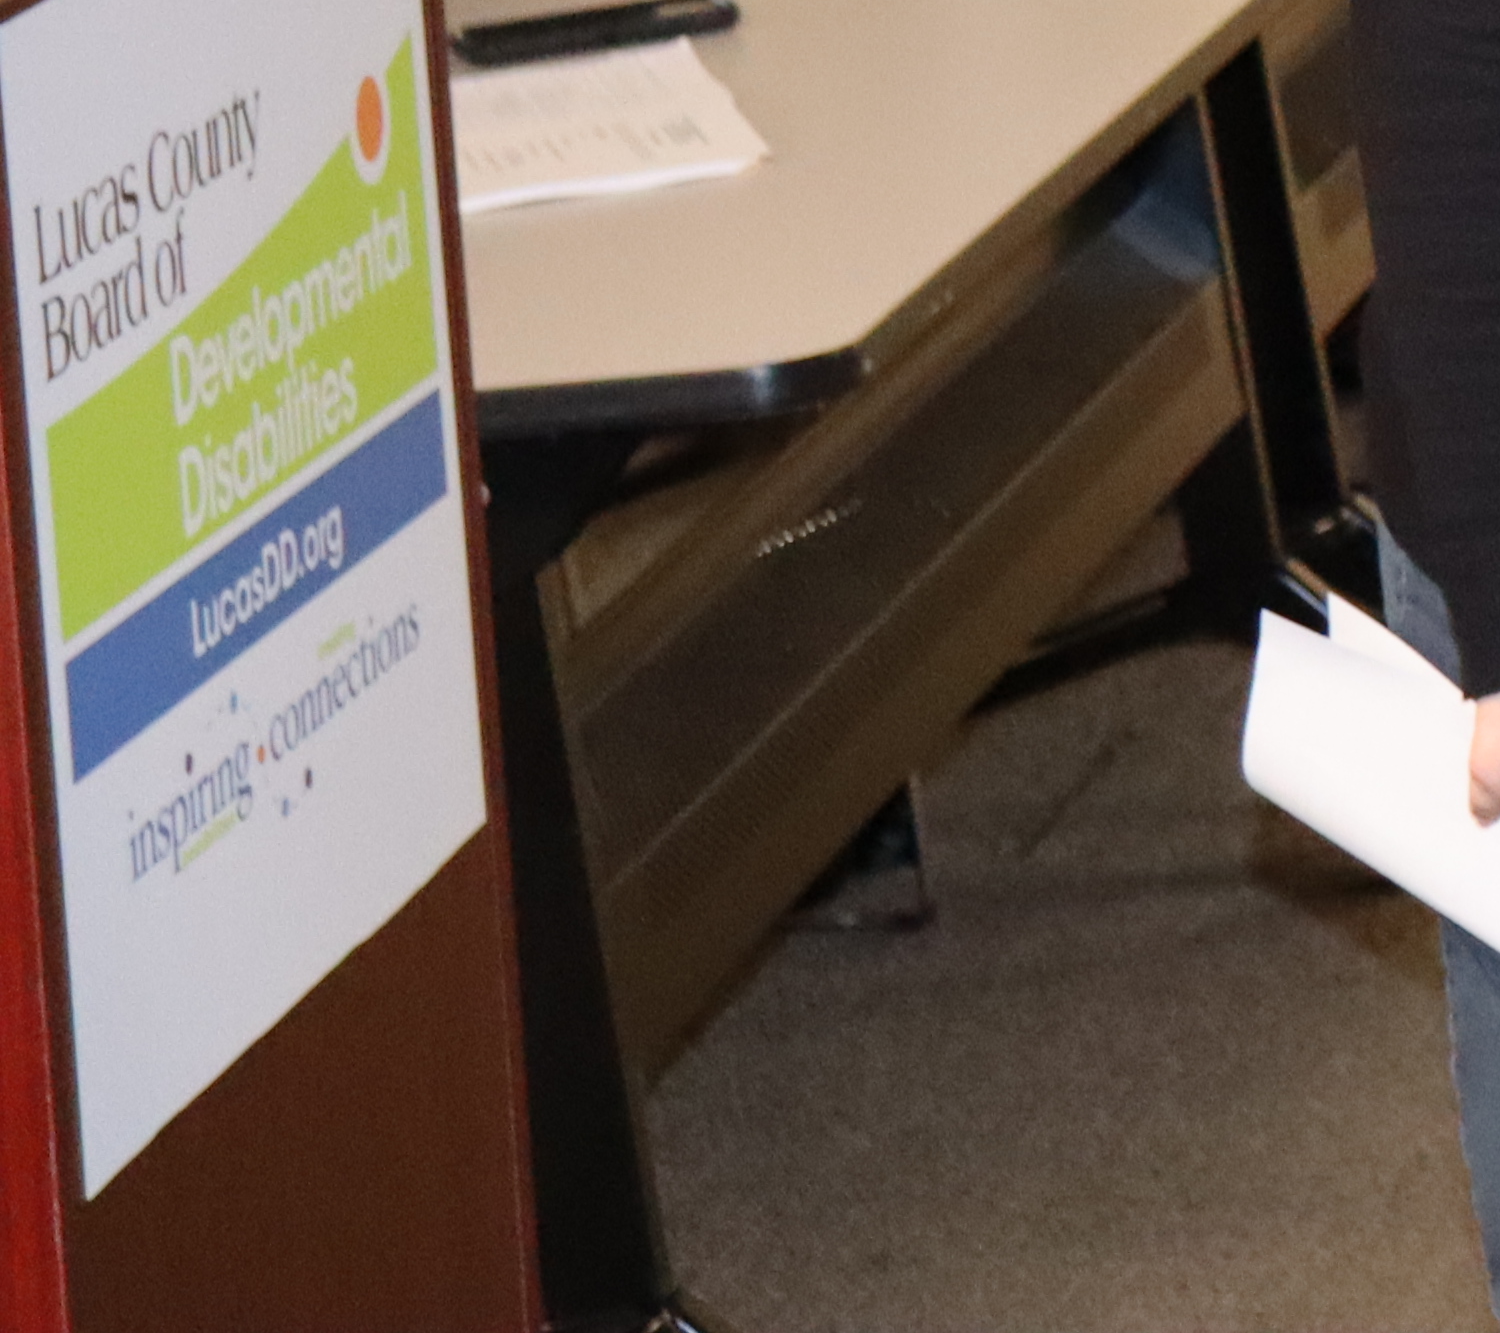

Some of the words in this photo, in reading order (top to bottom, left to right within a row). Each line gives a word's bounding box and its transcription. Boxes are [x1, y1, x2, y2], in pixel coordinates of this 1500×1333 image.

[33, 163, 141, 285] Lucas
[148, 90, 260, 212] County
[42, 235, 148, 383] Board
[155, 207, 187, 308] of
[168, 189, 412, 426] Developmental
[177, 358, 358, 538] Disabilities
[190, 505, 344, 658] LucasDD.org
[128, 741, 253, 882] inspiring
[268, 603, 421, 763] connections
